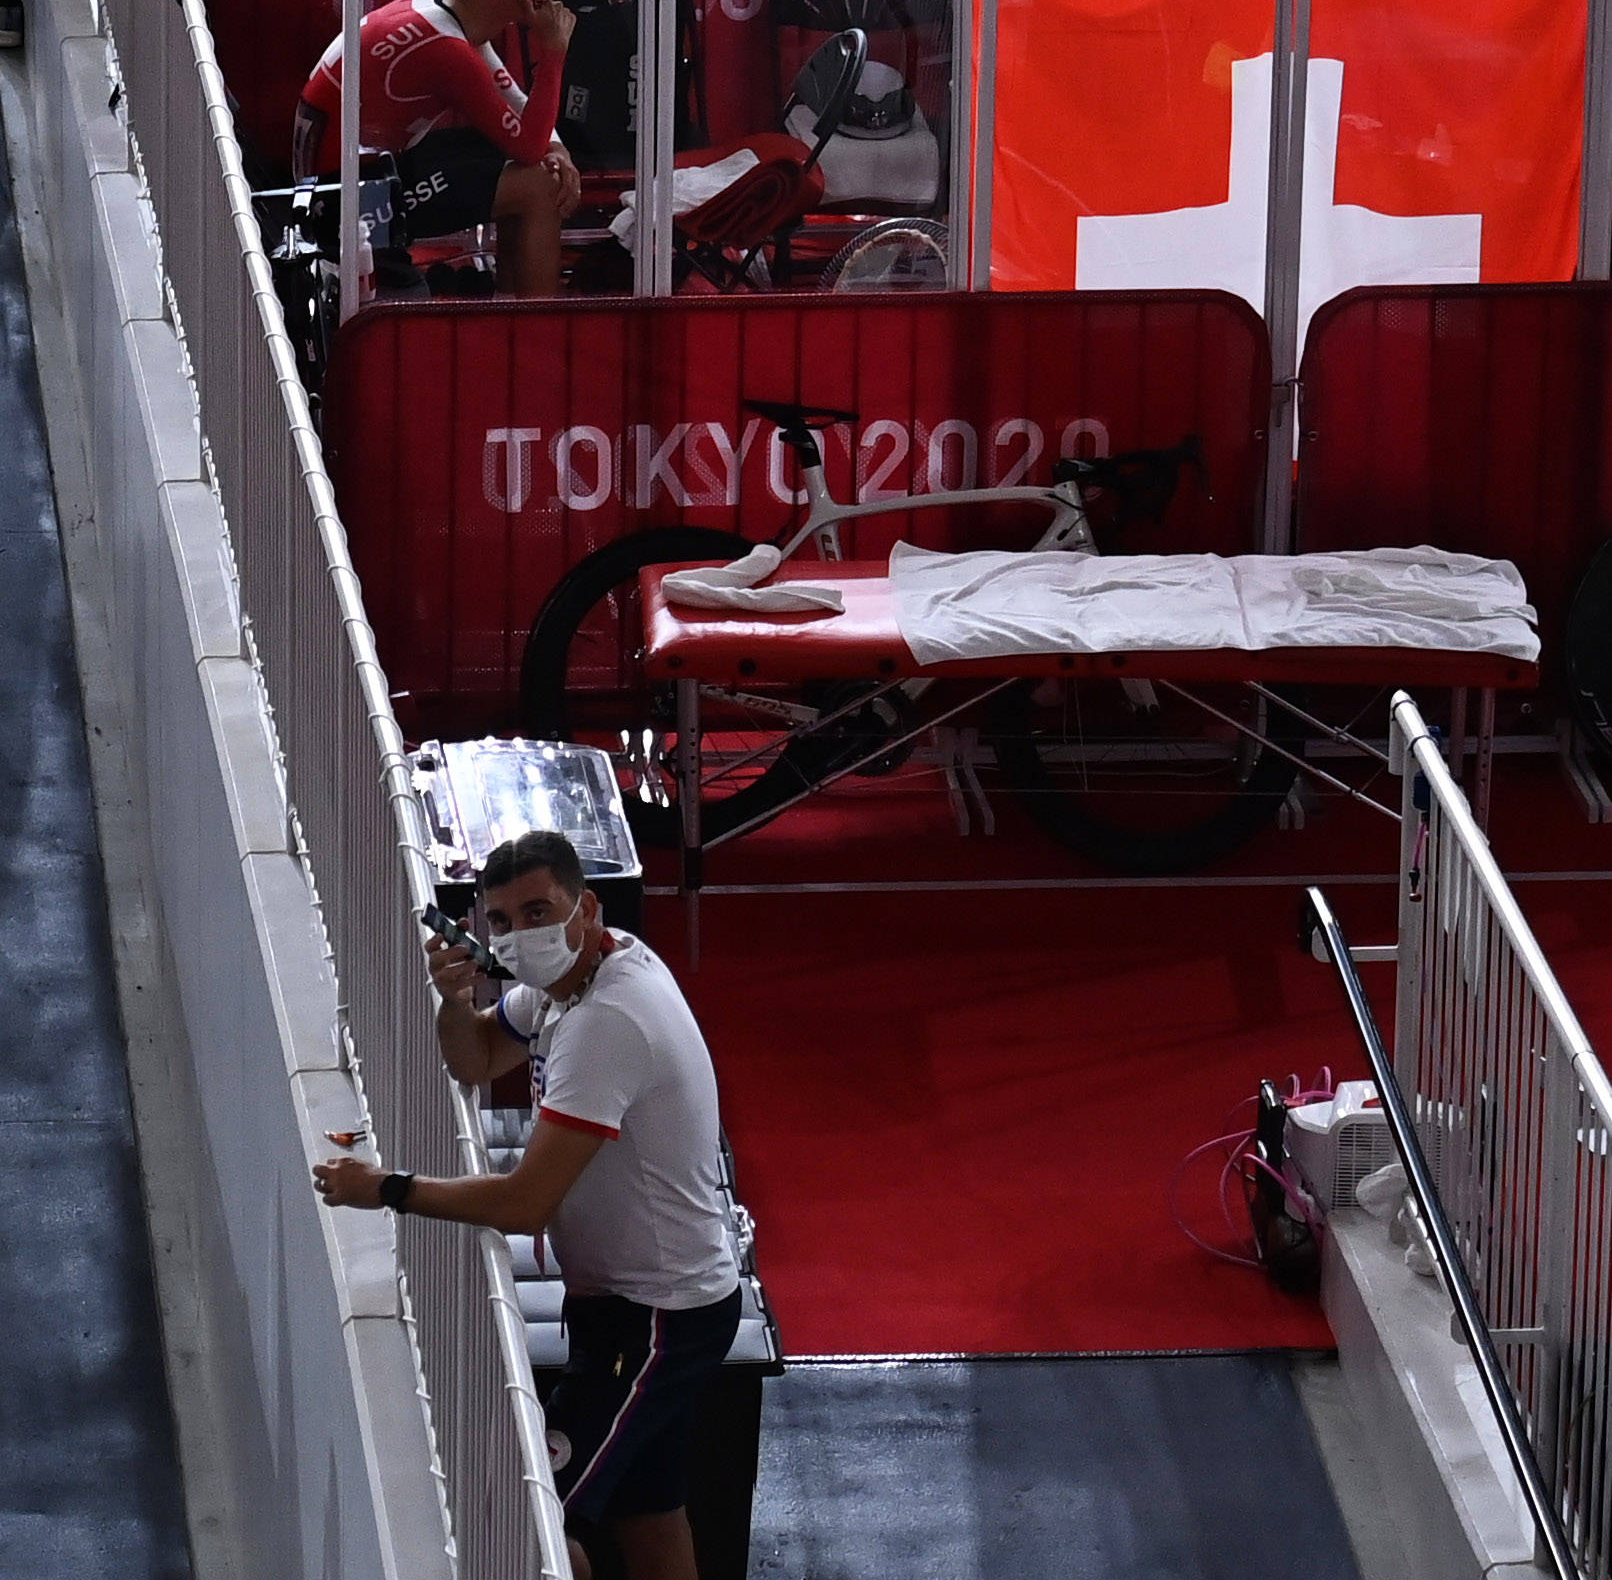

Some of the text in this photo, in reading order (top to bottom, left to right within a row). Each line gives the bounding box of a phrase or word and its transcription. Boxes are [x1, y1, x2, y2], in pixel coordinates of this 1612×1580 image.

[370, 22, 424, 61] SUI
[360, 171, 450, 229] SUSSE
[486, 418, 825, 513] TOKYO
